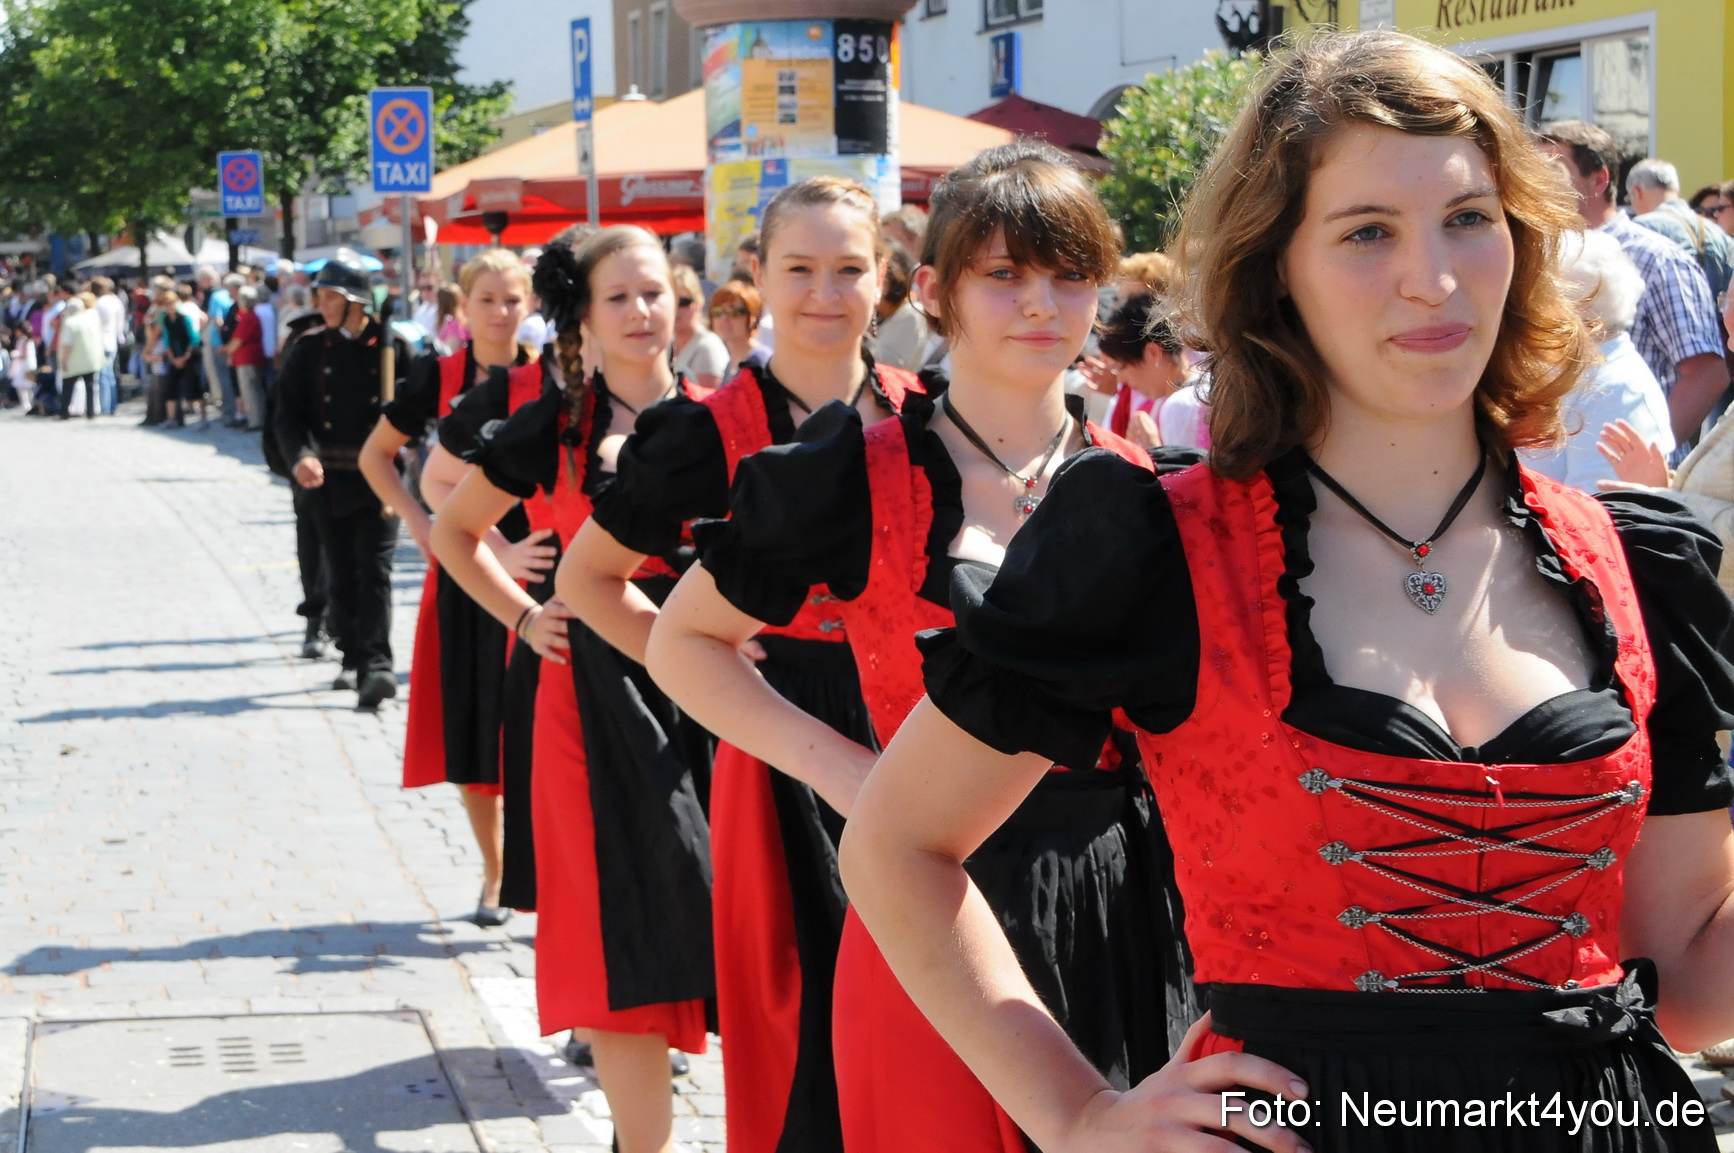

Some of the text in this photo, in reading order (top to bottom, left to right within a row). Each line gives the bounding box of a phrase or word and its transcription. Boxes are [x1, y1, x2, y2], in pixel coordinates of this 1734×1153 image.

[574, 28, 588, 88] P
[837, 33, 889, 64] 850
[376, 162, 427, 186] TAXI
[226, 196, 260, 211] TAXI
